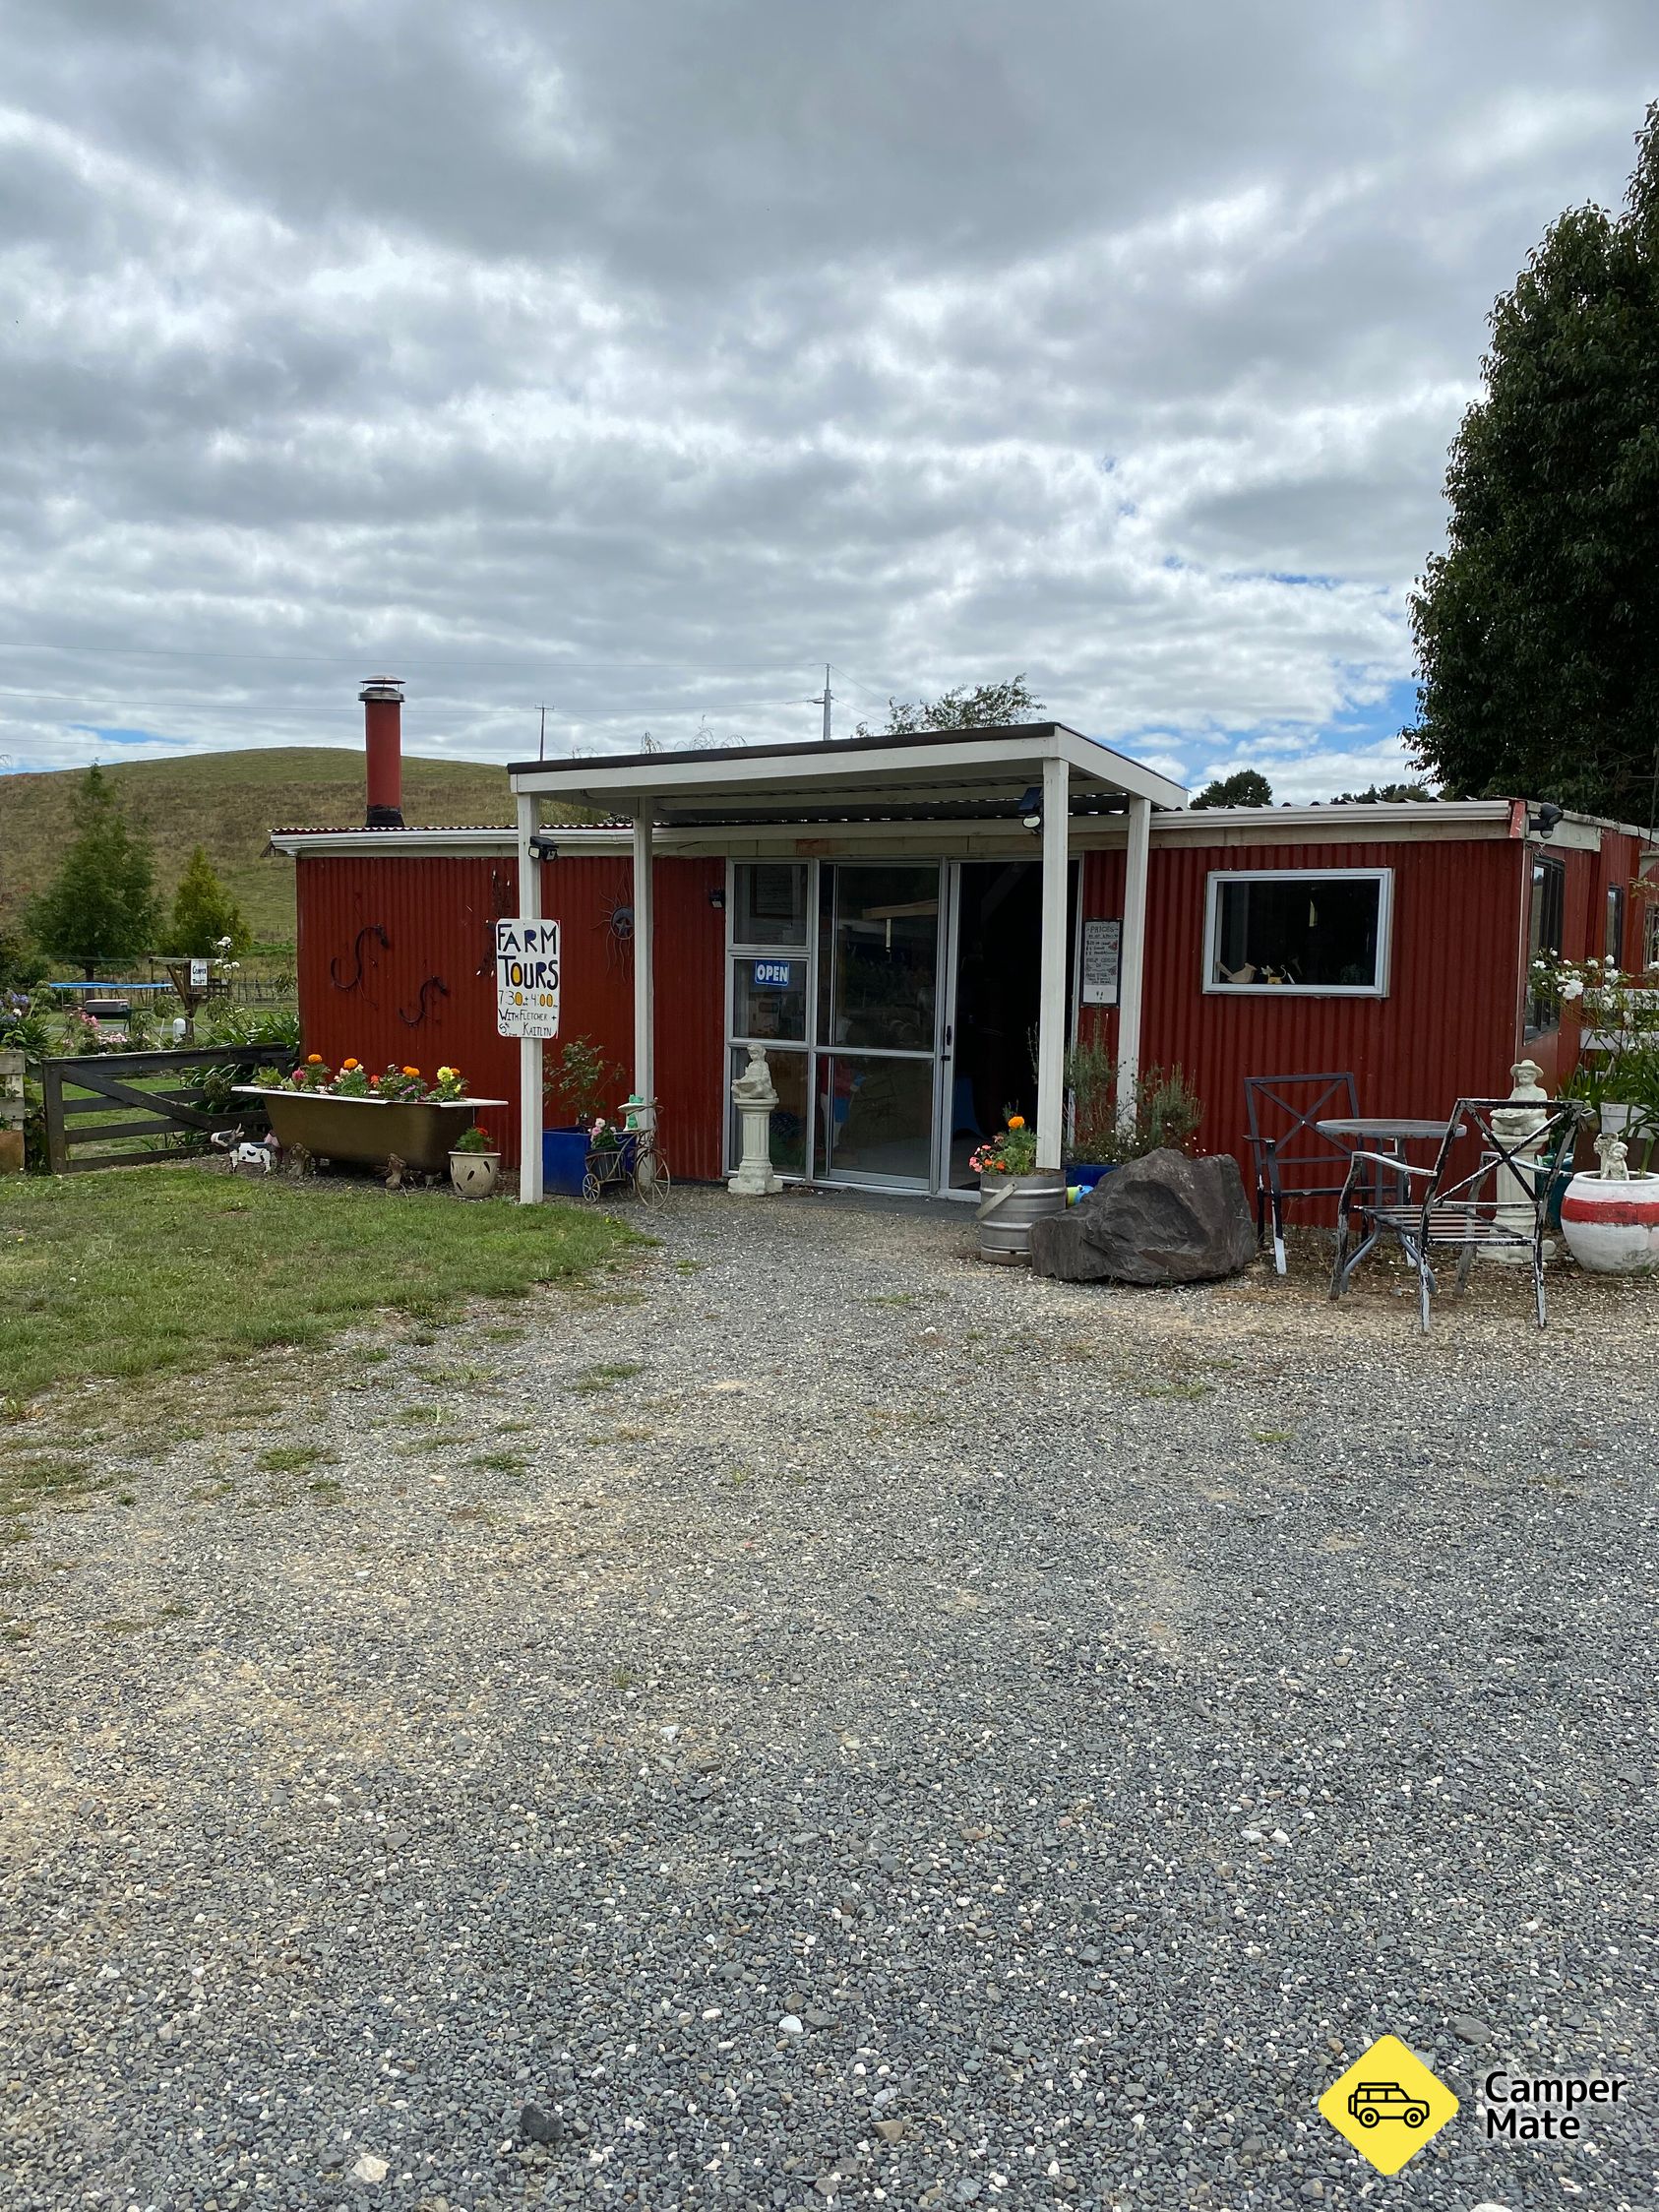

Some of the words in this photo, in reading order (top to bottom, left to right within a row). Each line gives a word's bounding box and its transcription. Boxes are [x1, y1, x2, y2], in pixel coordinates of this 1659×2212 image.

[498, 923, 557, 954] FARM
[498, 954, 559, 990] TOURS
[757, 963, 788, 982] OPEN
[498, 1008, 519, 1021] WITH
[520, 1009, 548, 1021] FLETCHER
[522, 1021, 552, 1037] KAITLYN
